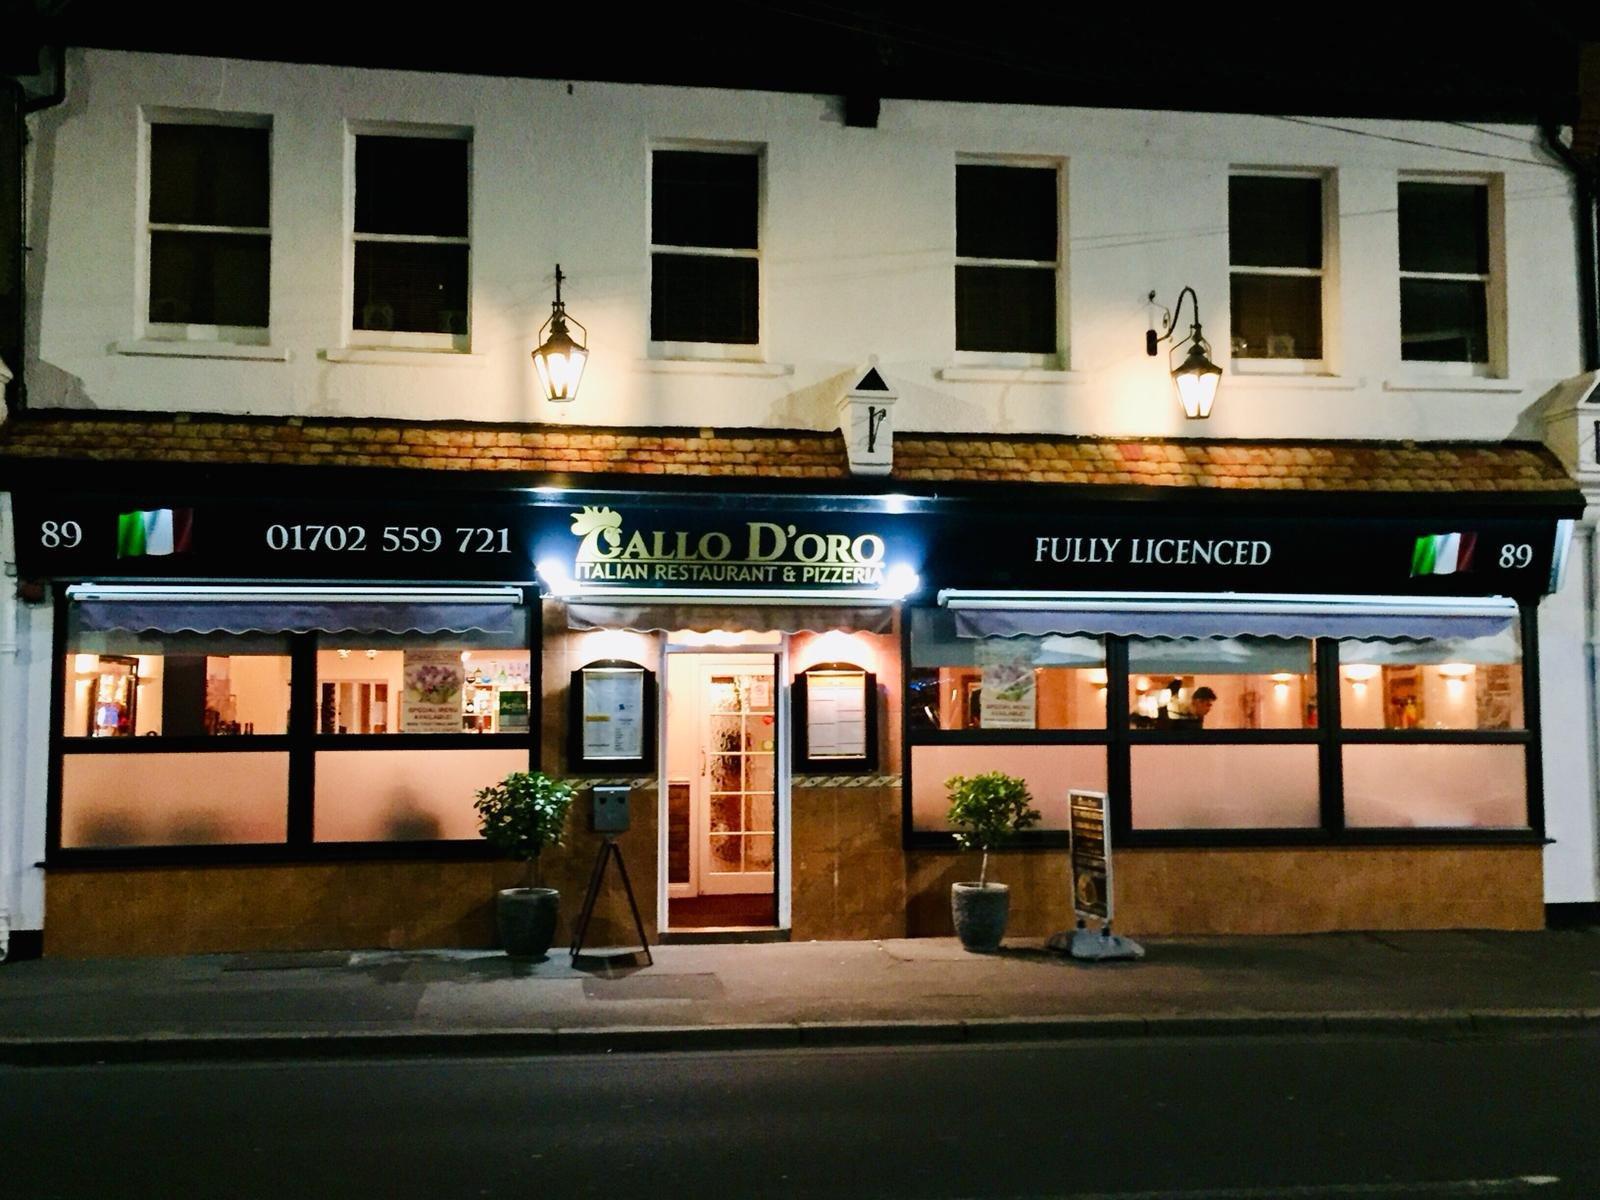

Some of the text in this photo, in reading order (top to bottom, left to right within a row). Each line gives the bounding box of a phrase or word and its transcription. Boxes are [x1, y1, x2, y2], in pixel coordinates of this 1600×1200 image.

[40, 520, 82, 548] 89
[266, 524, 512, 553] 01702 559 721
[580, 520, 885, 564] GALLO D'ORO
[1035, 537, 1272, 566] FULLY LICENCED
[1499, 543, 1533, 569] 89
[574, 562, 884, 585] ITALIAN RESTAURANT & PIZZERIA
